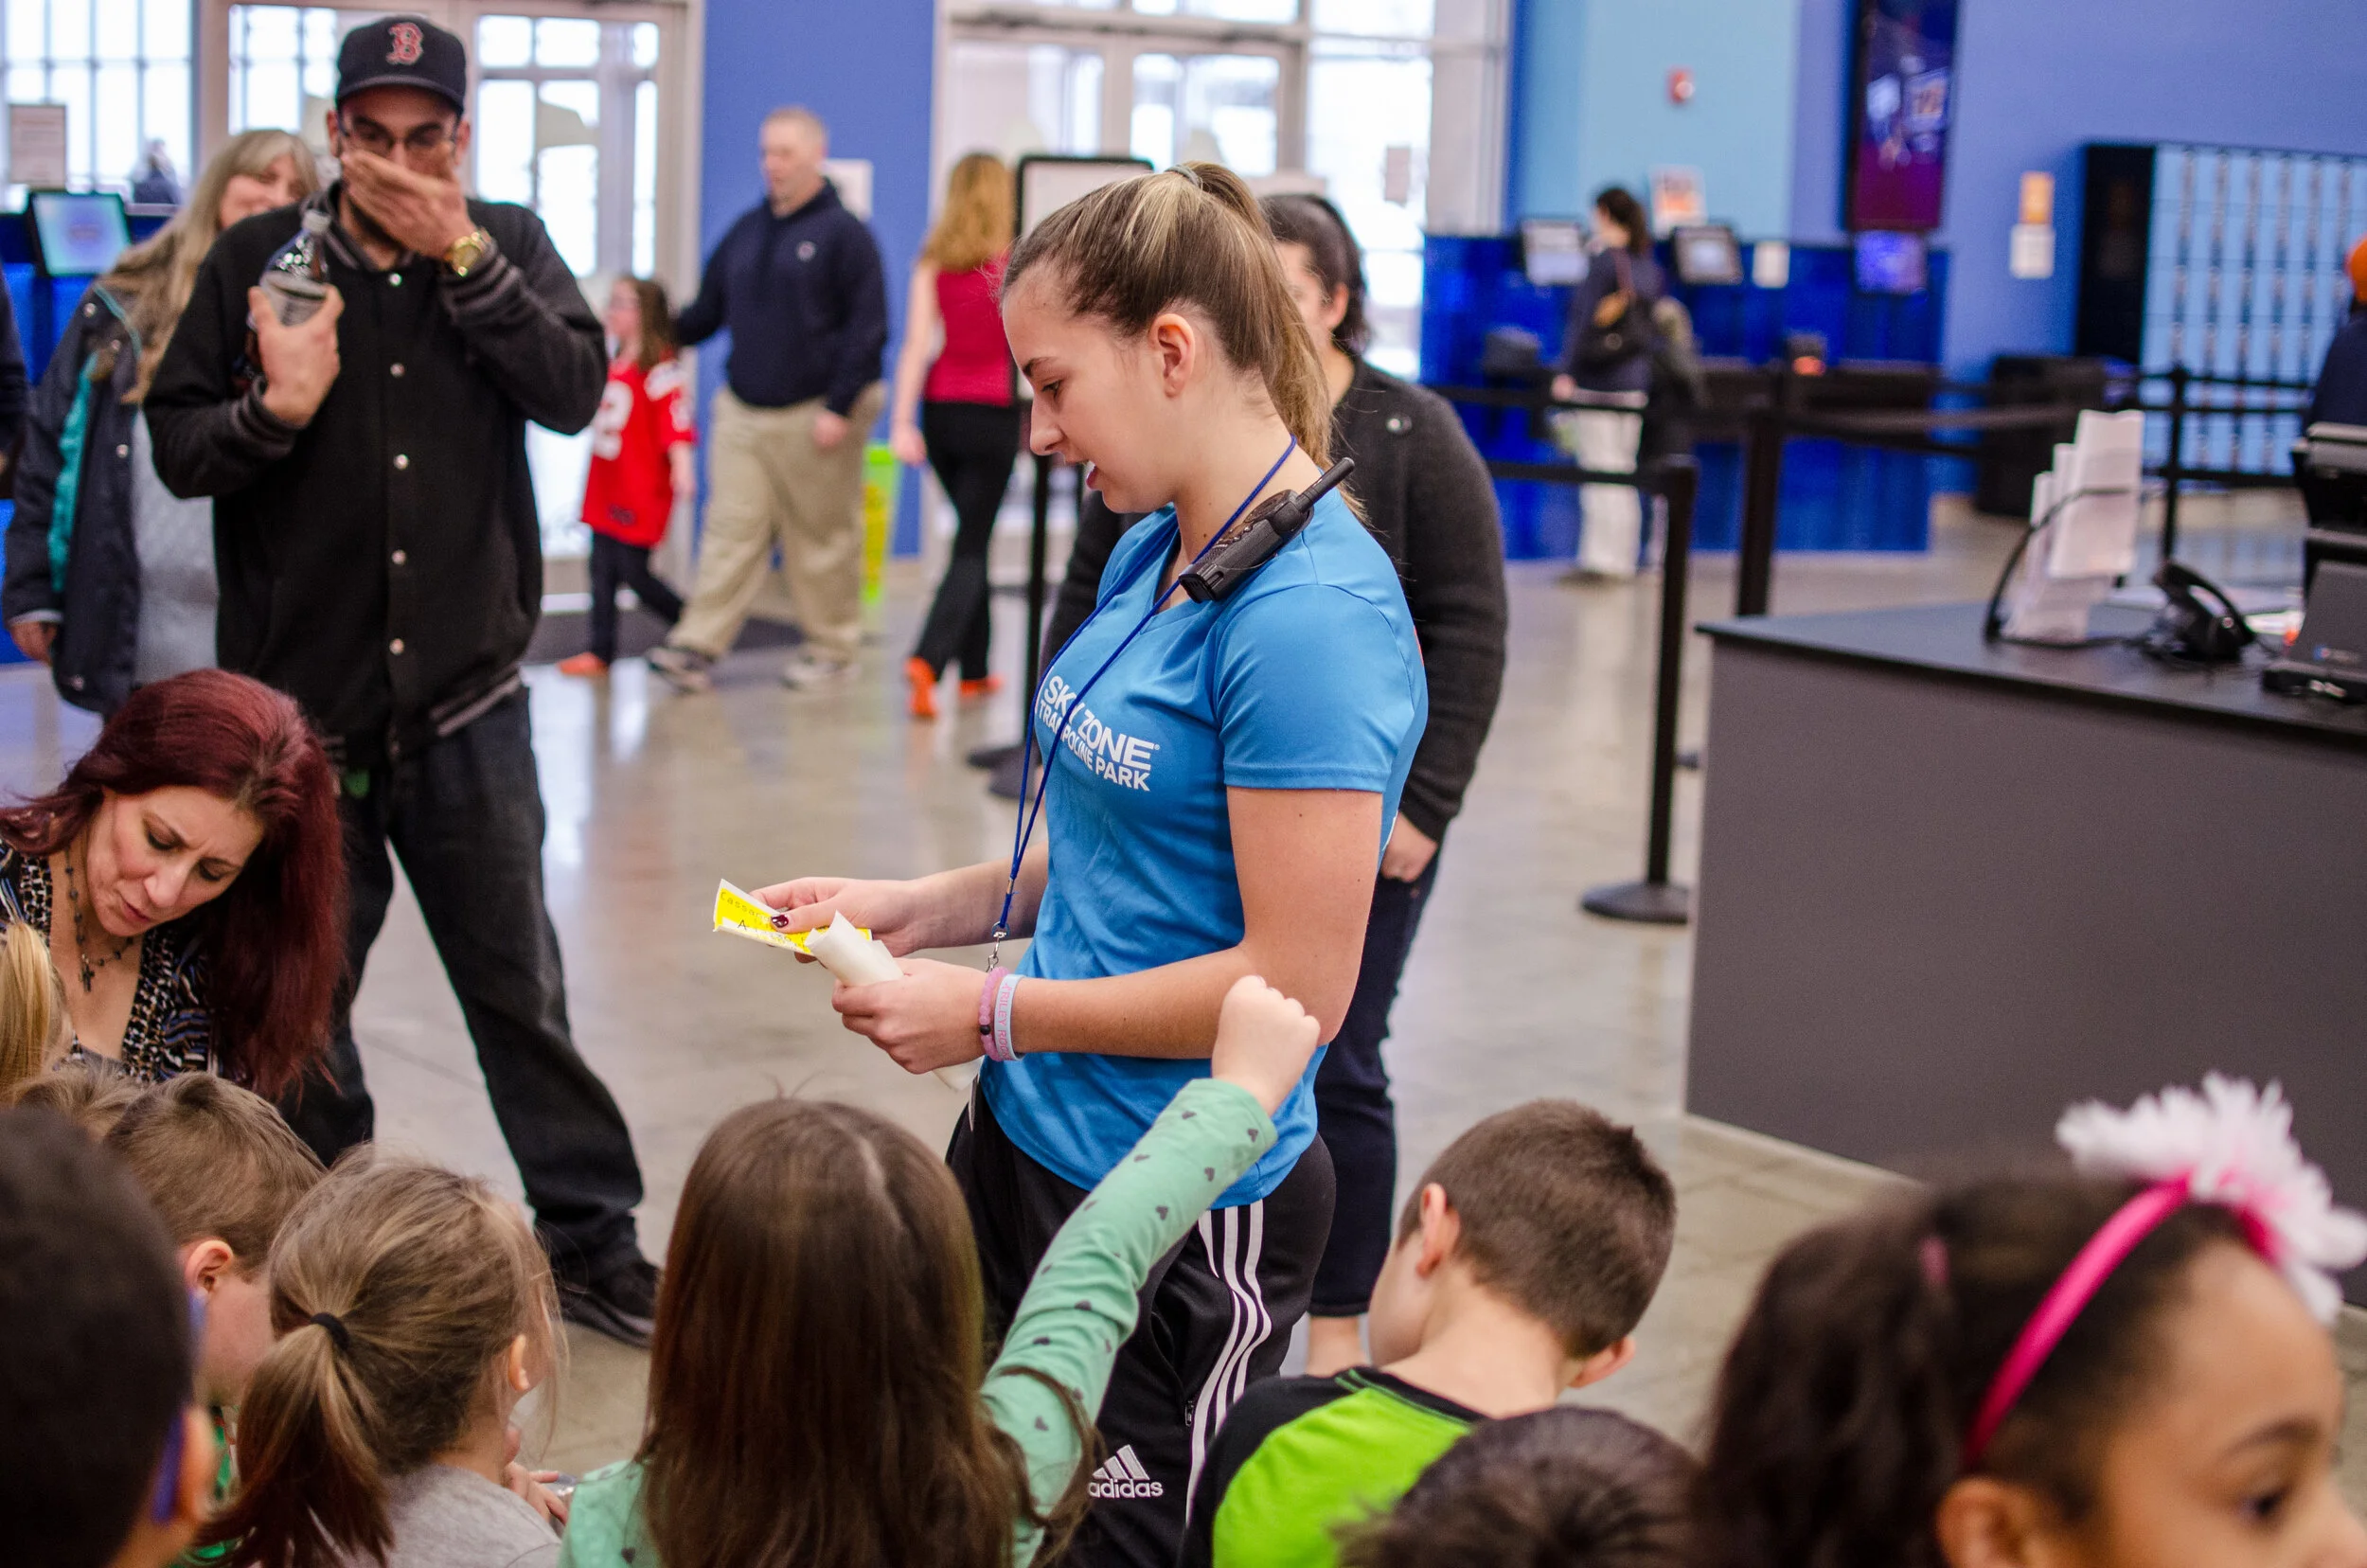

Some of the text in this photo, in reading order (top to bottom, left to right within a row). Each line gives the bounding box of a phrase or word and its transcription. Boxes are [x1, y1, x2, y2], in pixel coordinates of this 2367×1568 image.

[385, 22, 423, 65] B
[1043, 675, 1155, 771] SKY ZONE
[1095, 756, 1150, 793] PARK
[997, 991, 1009, 1026] RILEY
[1088, 1478, 1164, 1499] adidas
